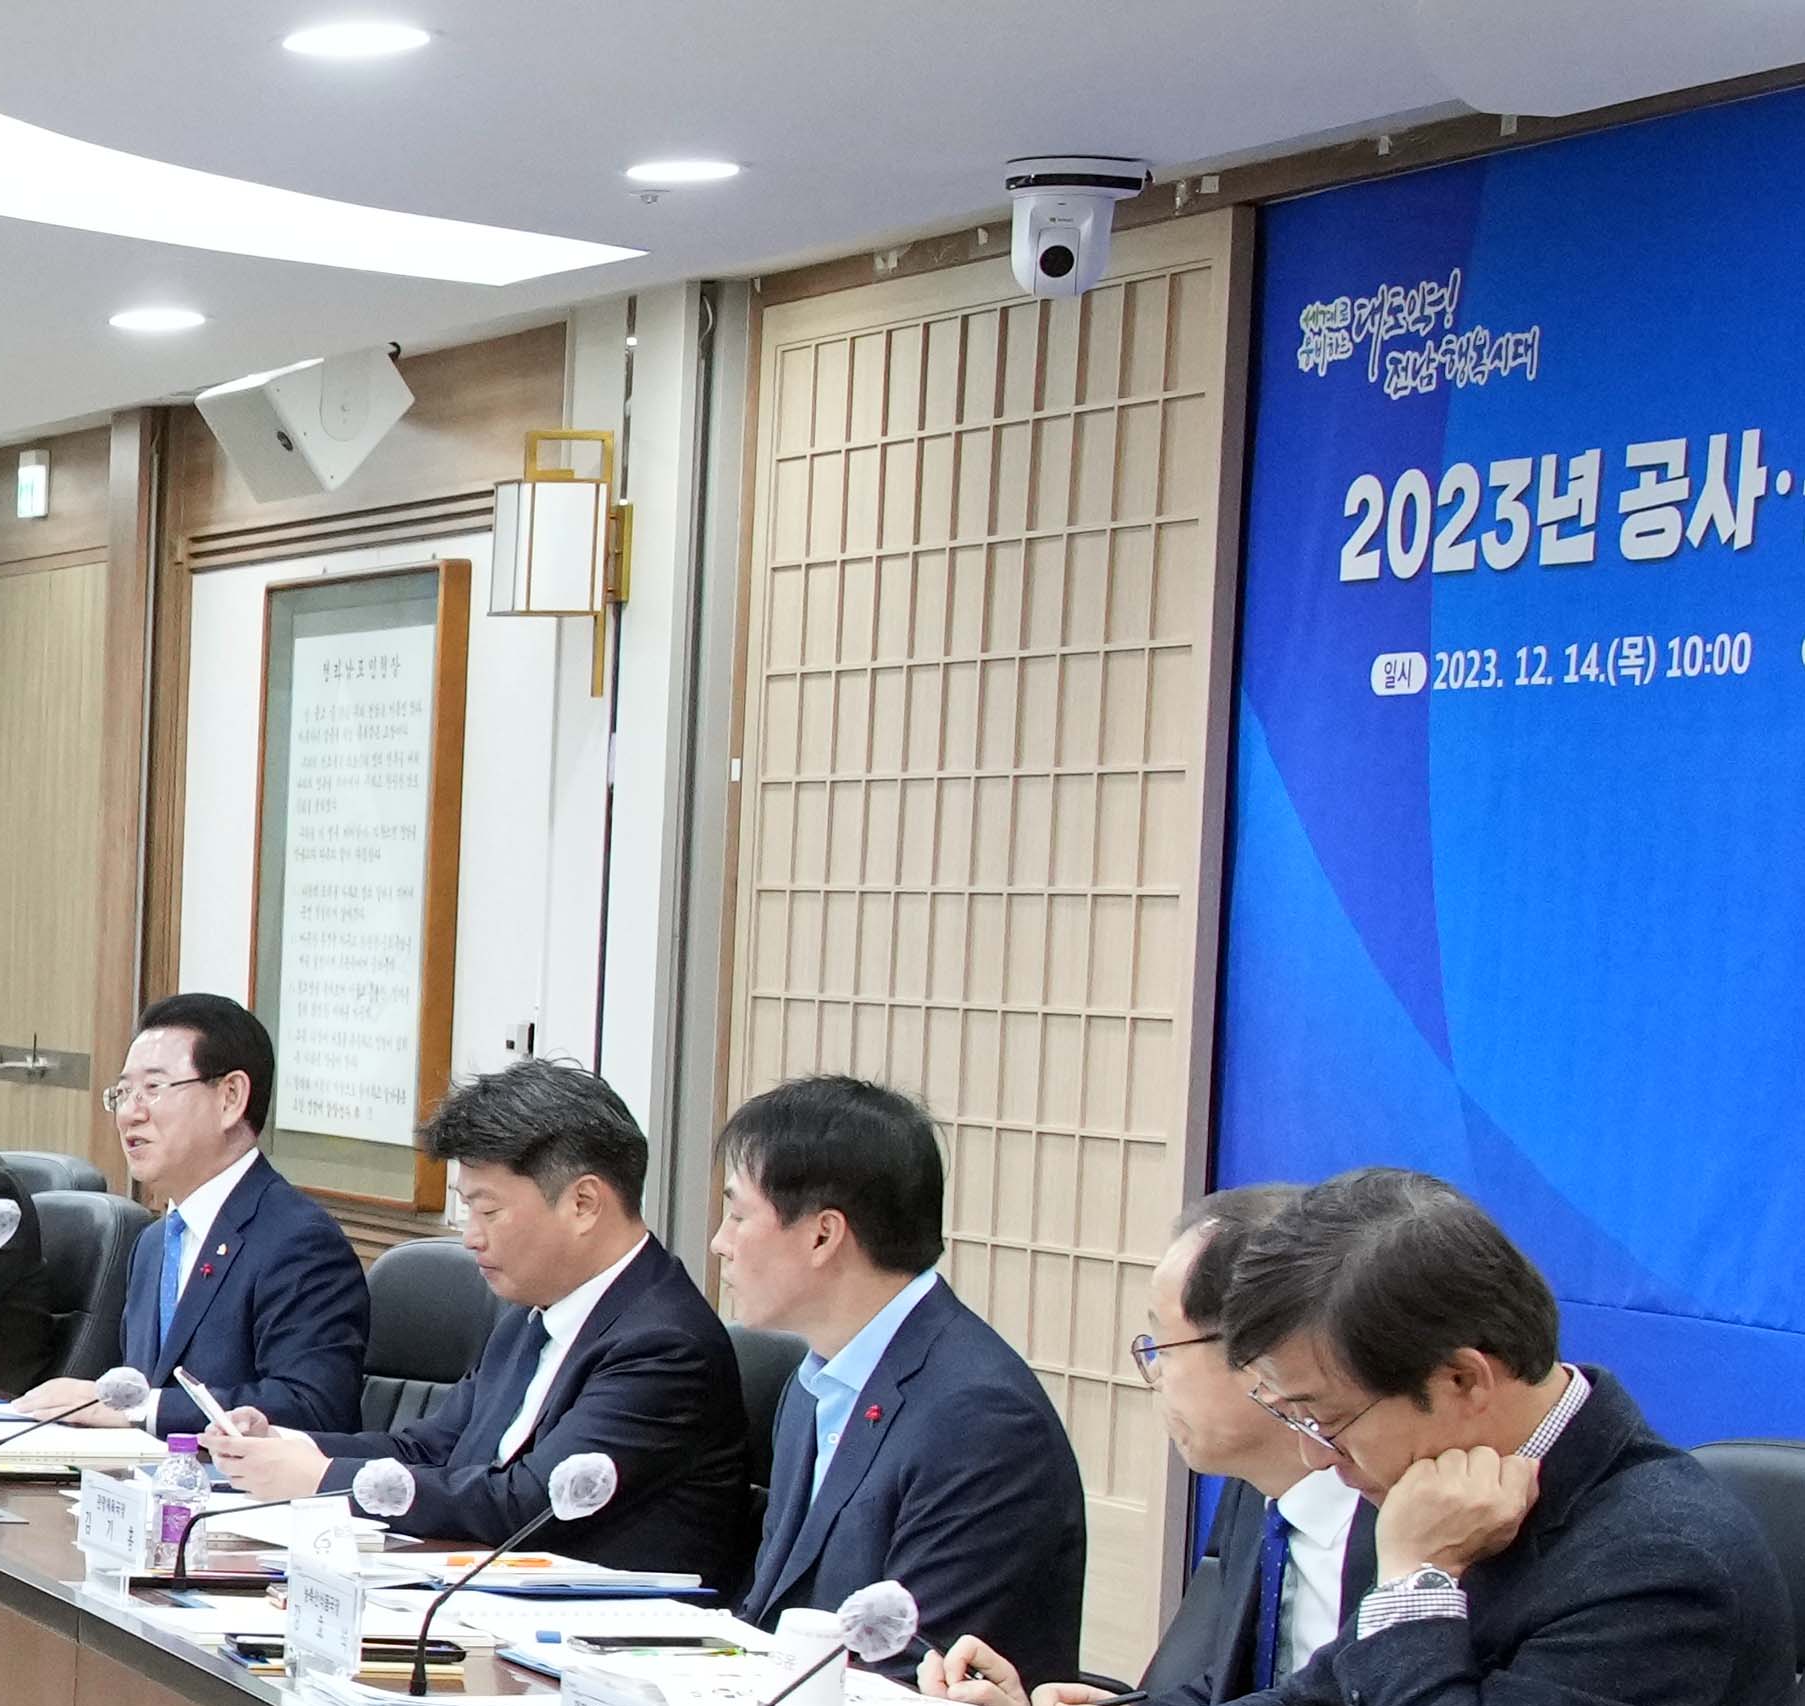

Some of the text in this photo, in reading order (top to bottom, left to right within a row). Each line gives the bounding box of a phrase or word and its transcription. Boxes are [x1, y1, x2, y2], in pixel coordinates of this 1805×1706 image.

[1299, 297, 1351, 331] 세계로
[1352, 268, 1461, 382] 대도약!
[1298, 330, 1353, 377] 웅비하는
[1384, 341, 1438, 400] 전남
[1339, 428, 1805, 582] 2023년 공사·
[1383, 660, 1413, 690] 일시
[1433, 648, 1503, 691] 2023.
[1515, 644, 1553, 687] 12.
[1666, 632, 1752, 678] 10:00
